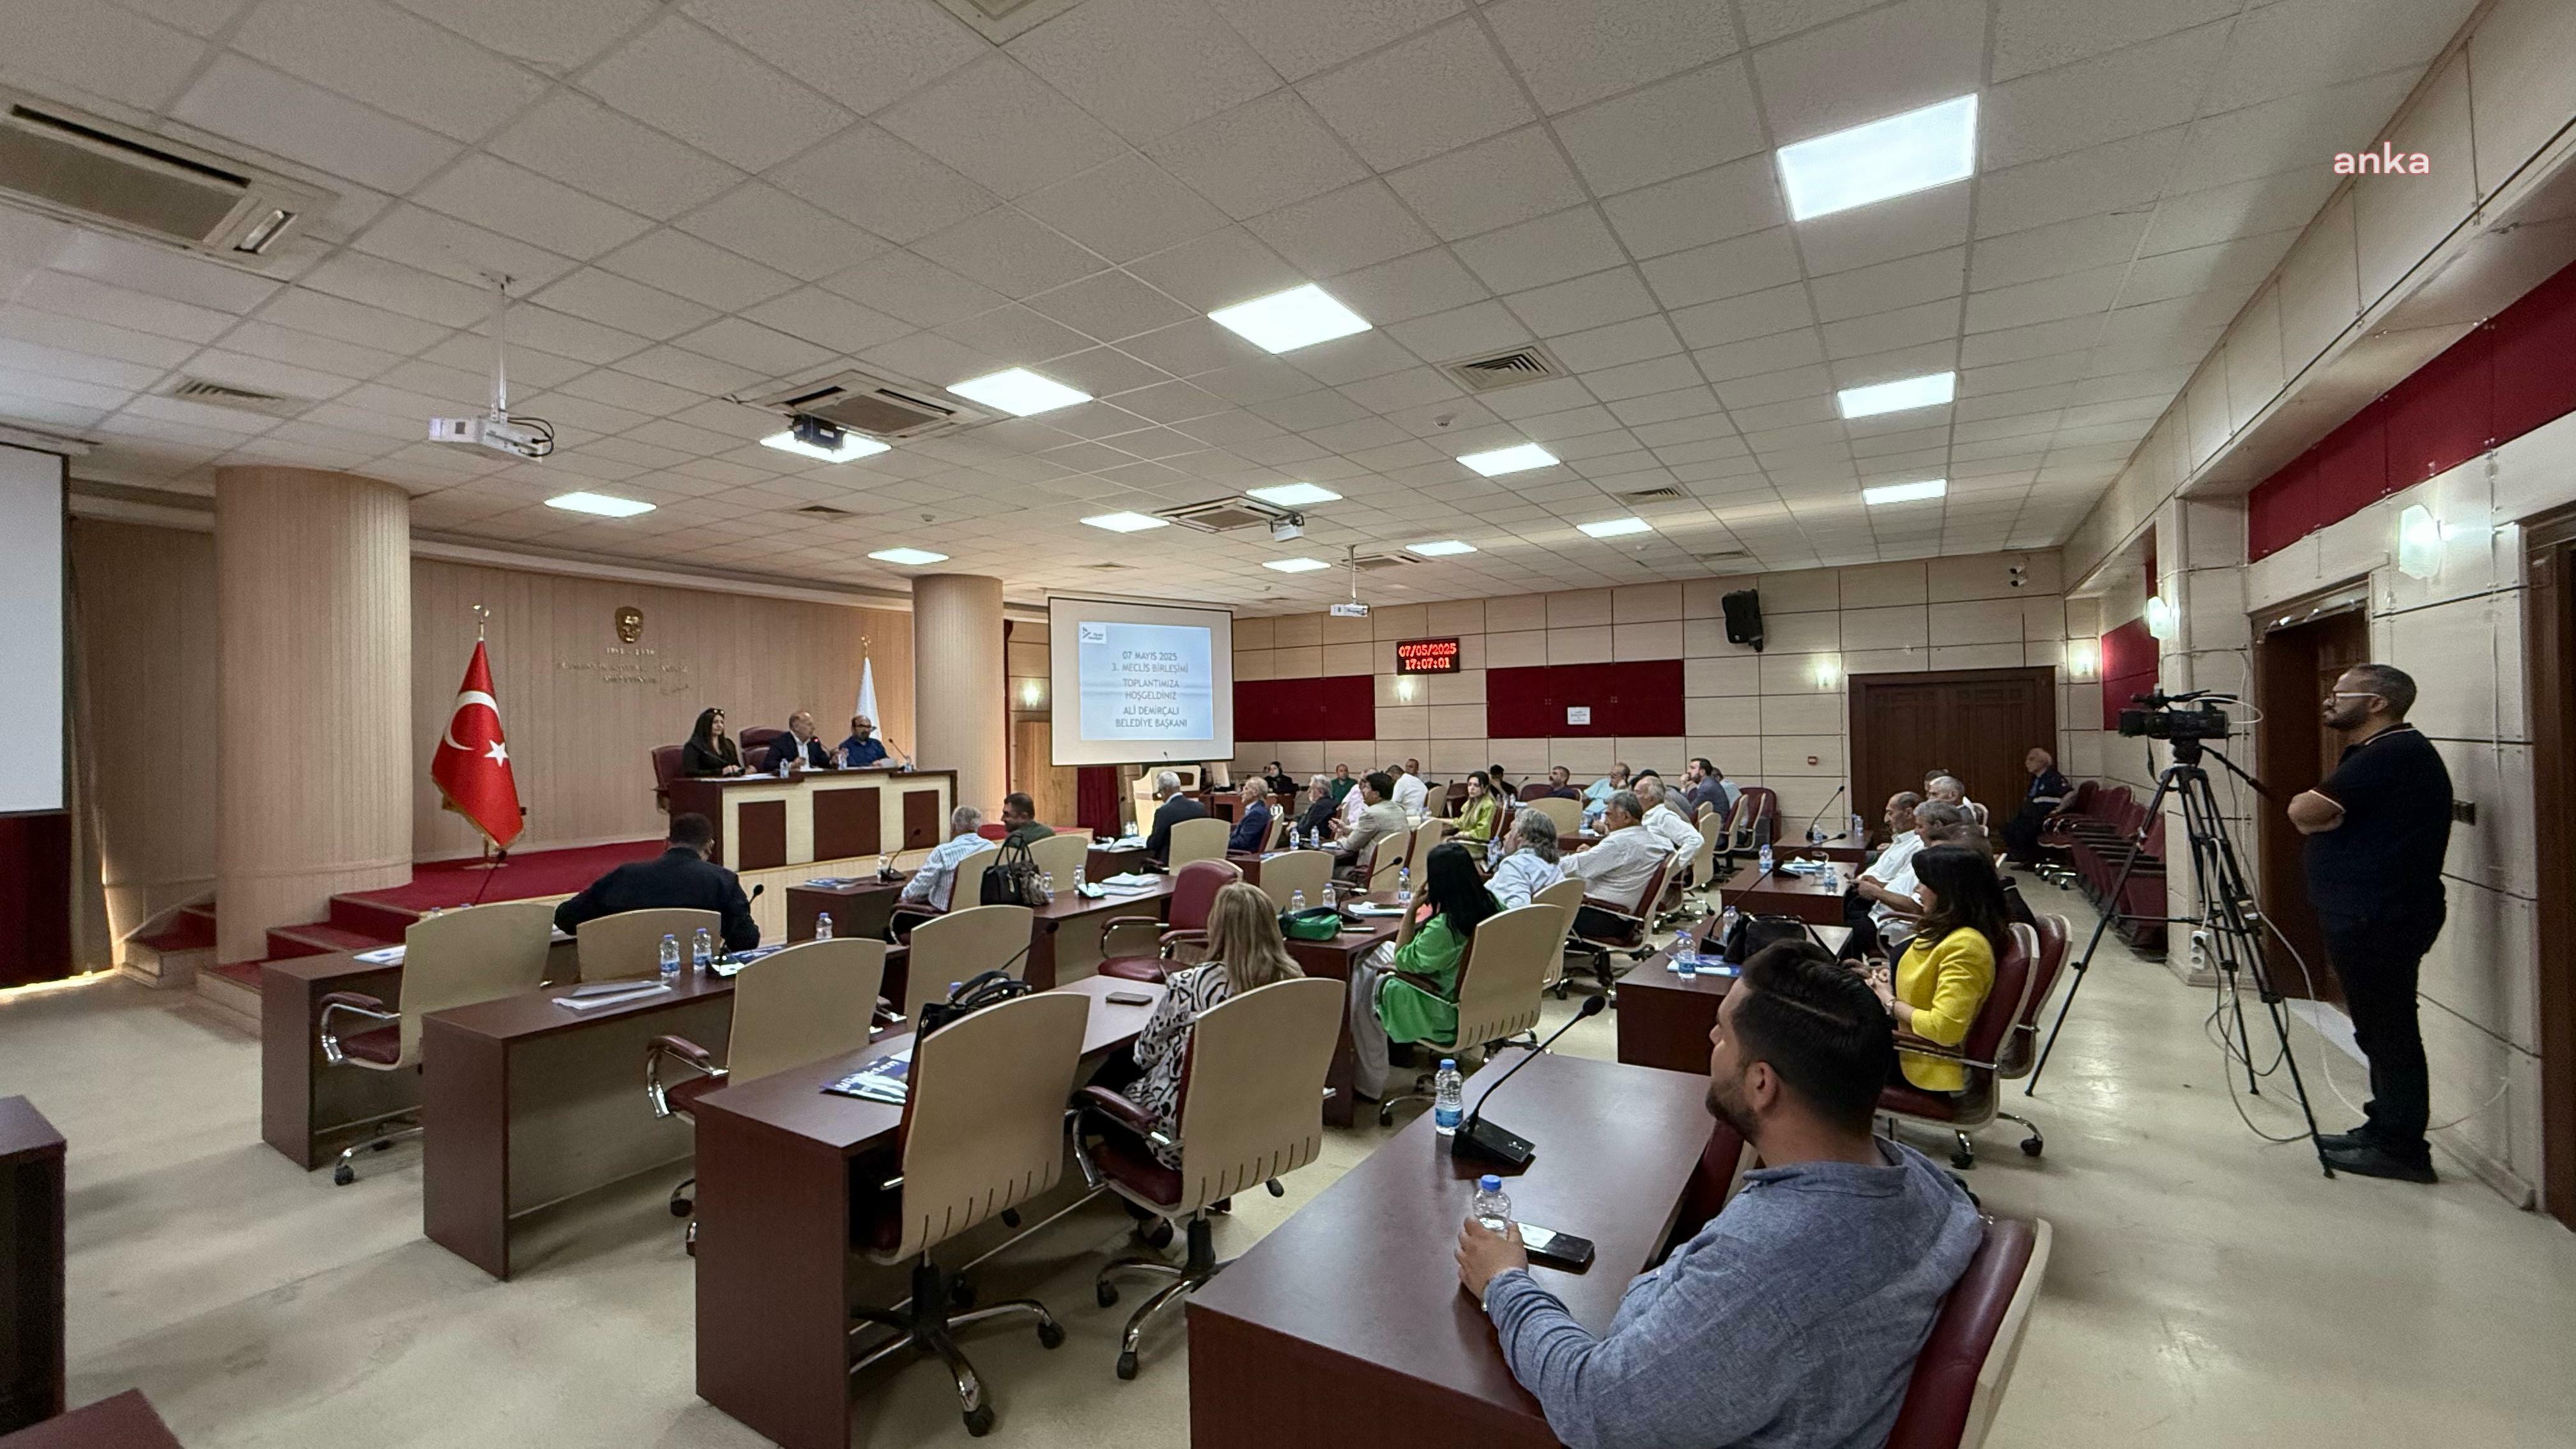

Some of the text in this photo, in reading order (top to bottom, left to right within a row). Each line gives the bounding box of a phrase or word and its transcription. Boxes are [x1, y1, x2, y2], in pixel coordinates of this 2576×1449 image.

[1123, 651, 1177, 661] 07 MAYIS 2025
[1399, 643, 1457, 657] 07/05/2025
[1405, 657, 1450, 670] 17:07:01
[1123, 678, 1179, 688] TOPLANTIMIZA
[1116, 717, 1187, 729] BELEDİYE BAŞKANI
